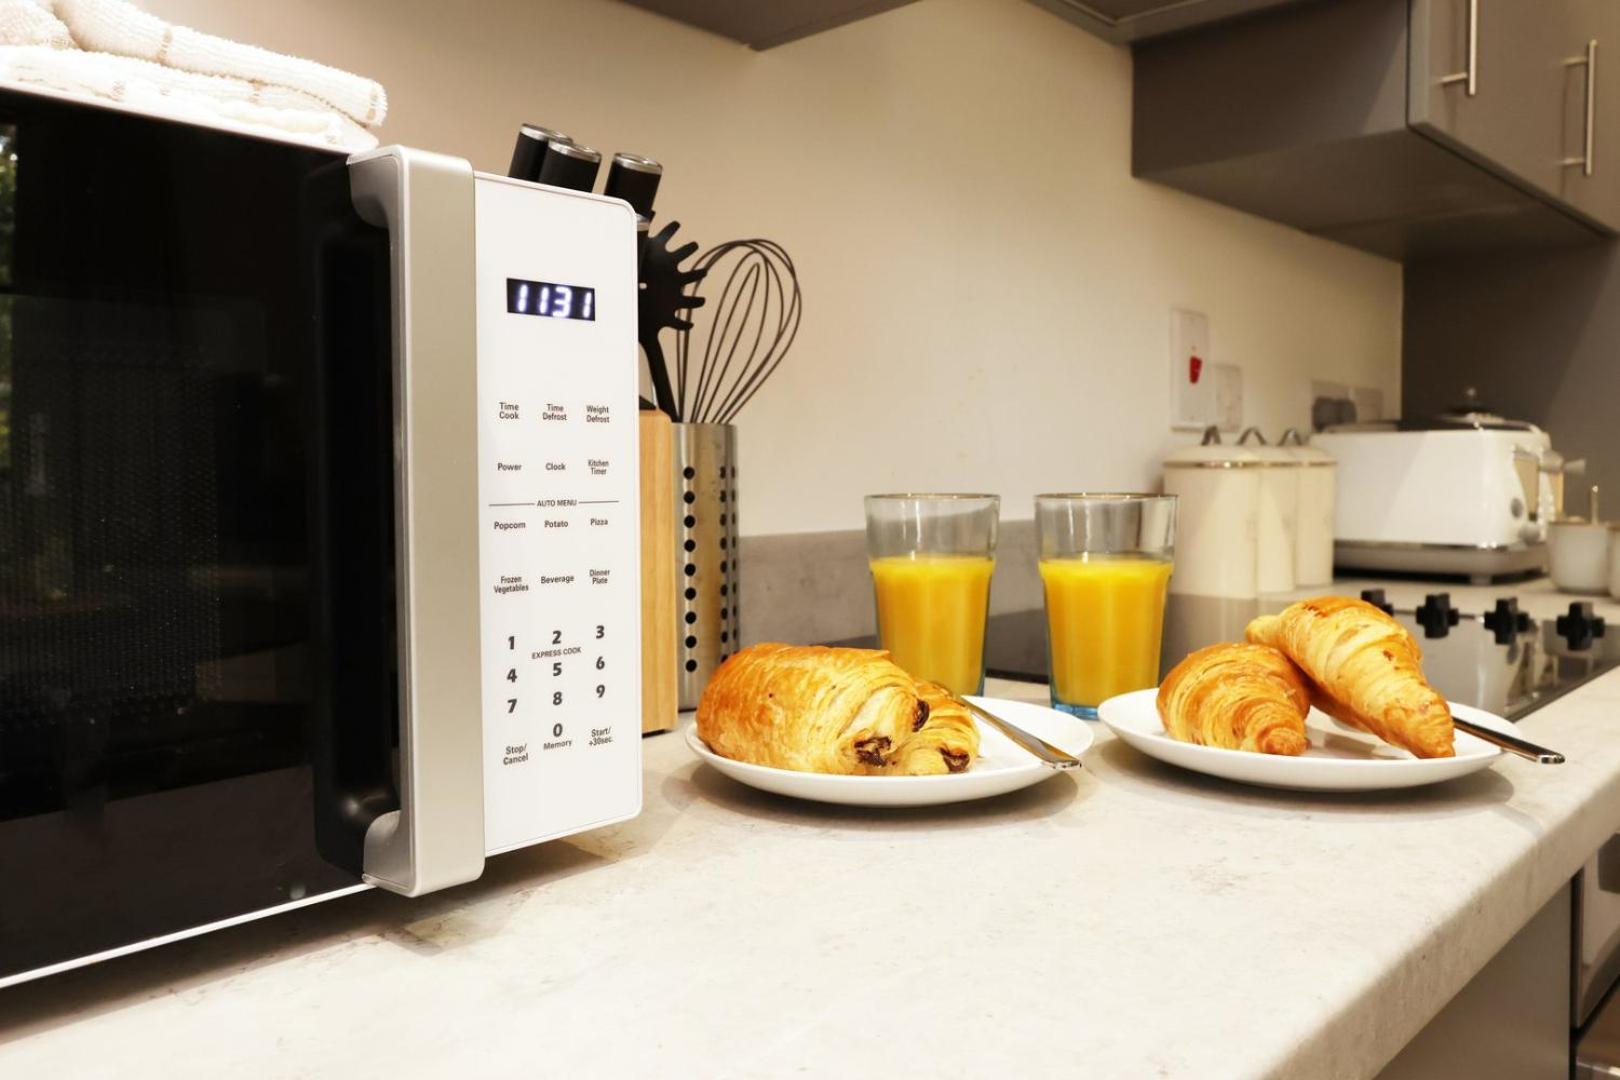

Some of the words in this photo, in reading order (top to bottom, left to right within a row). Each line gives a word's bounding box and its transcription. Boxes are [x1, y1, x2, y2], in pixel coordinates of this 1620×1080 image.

[518, 284, 592, 318] 1131
[499, 401, 519, 411] Time
[546, 403, 564, 412] Time
[586, 405, 609, 414] Weight
[499, 411, 519, 420] Cook
[543, 412, 567, 421] Defrost
[586, 414, 610, 423] Defrost
[498, 462, 521, 471] Power
[545, 462, 566, 471] Clock
[588, 459, 609, 467] Kitchen
[591, 467, 607, 475] Timer
[494, 521, 525, 531] Popcorn
[544, 519, 568, 528] Potato
[590, 518, 608, 526] Pizza
[589, 569, 610, 577] Dinner
[501, 575, 522, 584] Frozen
[540, 575, 574, 584] Beverage
[494, 584, 528, 594] Vegetables
[596, 625, 605, 639] 3
[552, 630, 562, 645] 2
[508, 636, 515, 650] 1
[532, 649, 562, 660] EXPRESS
[563, 646, 582, 656] COOK
[596, 656, 605, 670] 6
[552, 662, 562, 676] 5
[507, 668, 517, 683] 4
[596, 684, 606, 698] 9
[552, 691, 563, 706] 8
[507, 698, 517, 713] 7
[553, 722, 563, 737] 0
[591, 726, 611, 738] Start/
[505, 743, 527, 755] Stop/
[543, 740, 573, 750] Memory
[503, 752, 529, 766] Cancel
